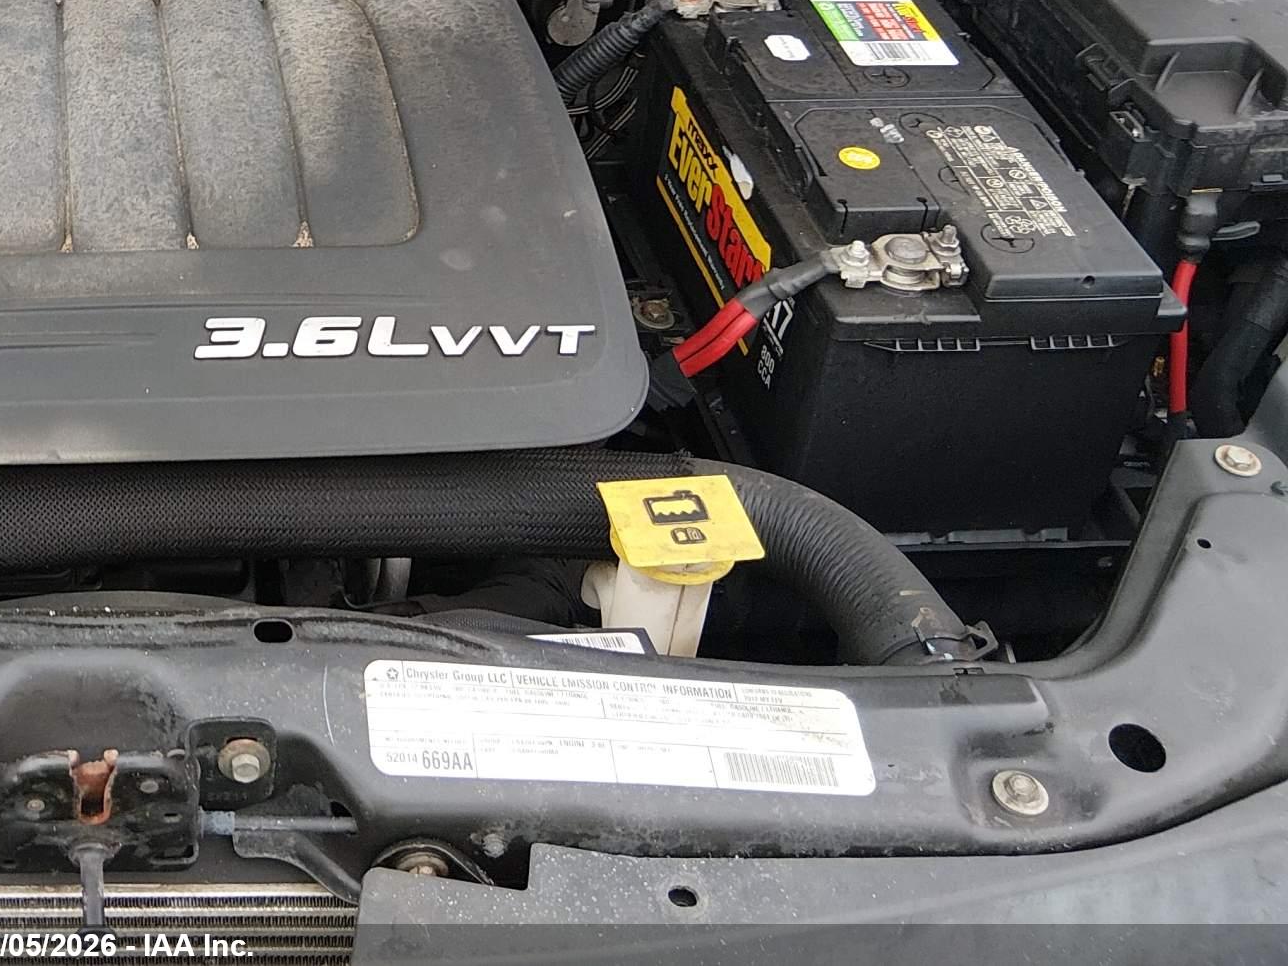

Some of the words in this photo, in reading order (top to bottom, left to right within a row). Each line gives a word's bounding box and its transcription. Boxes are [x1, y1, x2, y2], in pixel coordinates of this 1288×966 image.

[429, 325, 596, 357] VVT
[757, 359, 771, 390] CCA
[761, 344, 775, 375] 800
[406, 666, 449, 681] Chrysler
[452, 670, 484, 684] Group
[487, 671, 507, 684] LLC
[516, 673, 559, 688] VEHICLE
[561, 677, 610, 690] EMISSION
[662, 684, 732, 699] INFORMATION
[422, 750, 474, 771] 669AA
